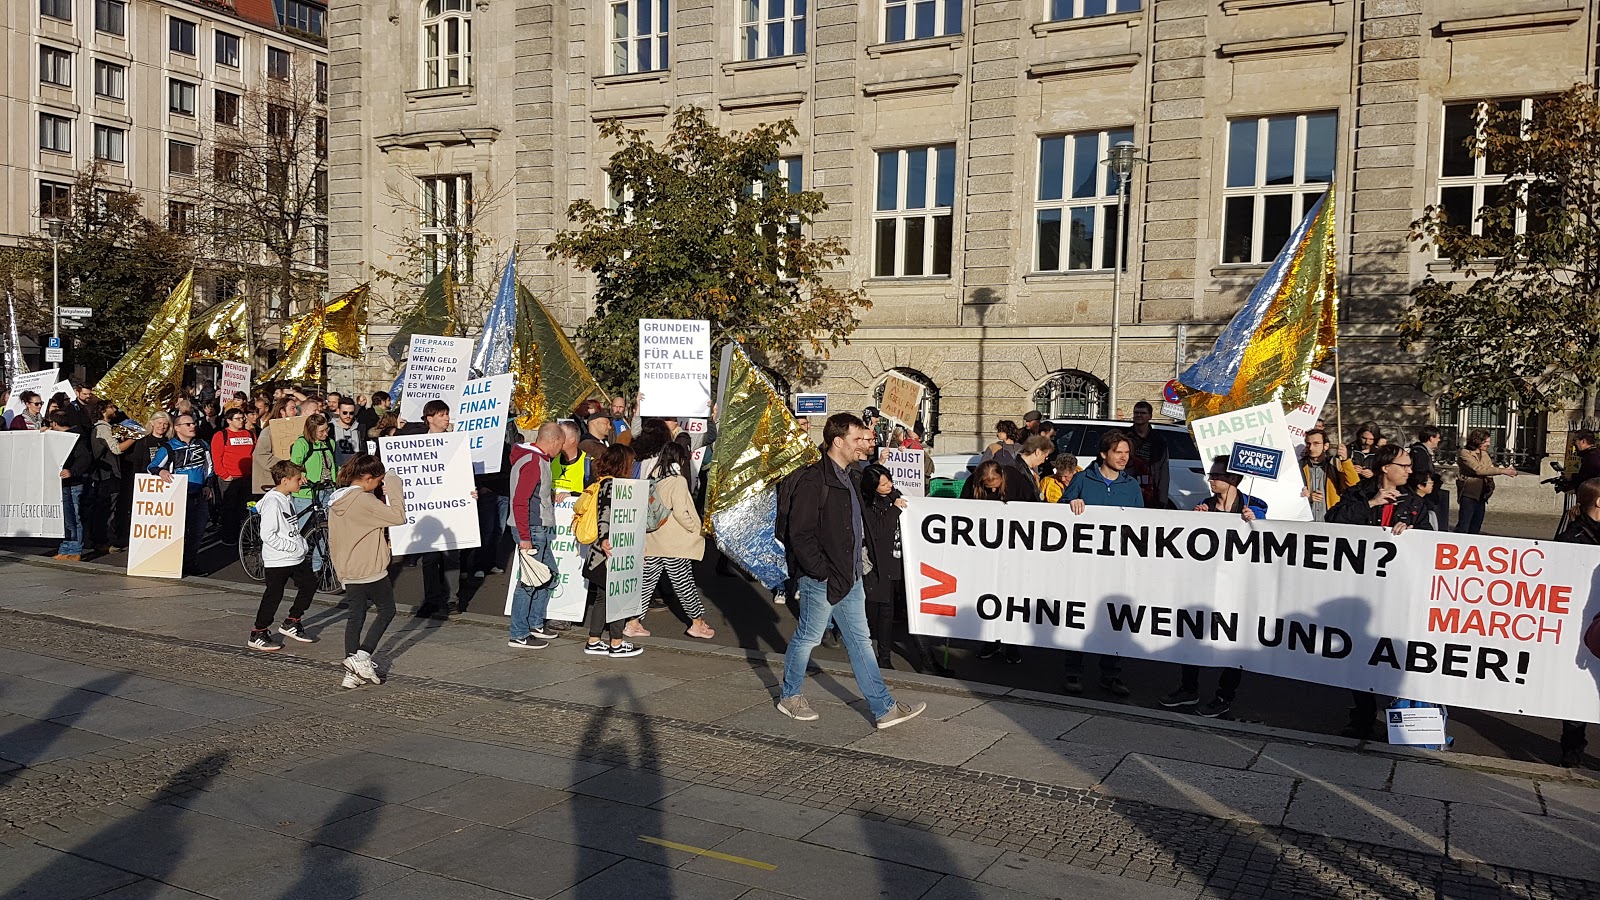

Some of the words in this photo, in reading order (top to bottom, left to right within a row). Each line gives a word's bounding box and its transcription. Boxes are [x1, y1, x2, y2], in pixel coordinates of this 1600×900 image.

[644, 323, 705, 332] GRUNDEIN-
[644, 336, 693, 345] KOMMEN
[645, 347, 668, 359] FÜR
[672, 350, 704, 360] ALLE
[225, 362, 248, 372] WENIGER
[410, 364, 444, 372] EINFACH
[644, 362, 673, 370] STATT
[224, 371, 246, 380] MÜSSEN
[644, 372, 708, 380] NEIDDEBATTEN
[224, 380, 241, 388] FÜHRT
[462, 380, 492, 396] ALLE
[460, 398, 501, 414] FINAN-
[457, 415, 499, 432] ZIEREN
[1199, 408, 1273, 440] HABEN
[385, 438, 449, 450] GRUNDEIN-
[470, 436, 484, 449] LE
[387, 451, 438, 463] KOMMEN
[888, 452, 920, 463] RAUST
[1238, 450, 1275, 460] ANDREW
[1239, 455, 1273, 468] YANG
[422, 464, 445, 473] NUR
[897, 468, 920, 479] DICH
[138, 478, 170, 493] VER-
[416, 476, 443, 486] ALLE
[893, 480, 921, 488] ERTRAUEN?
[404, 491, 415, 500] ND
[615, 485, 632, 500] WAS
[136, 501, 174, 516] TRAU
[404, 499, 471, 512] EDINGUNGS-
[613, 508, 637, 524] FEHLT
[134, 523, 172, 539] DICH!
[612, 532, 635, 548] WENN
[921, 514, 1398, 577] GRUNDEINKOMMEN?
[551, 542, 574, 552] MEN
[610, 555, 634, 572] ALLES
[1434, 543, 1545, 577] BASIC
[610, 582, 619, 596] DA
[622, 578, 638, 594] IST?
[1430, 575, 1572, 614] INCOME
[1428, 607, 1562, 644] MARCH
[976, 594, 1086, 630] OHNE
[1106, 602, 1239, 642] WENN
[1258, 616, 1352, 659] UND
[1368, 637, 1530, 685] ABER!
